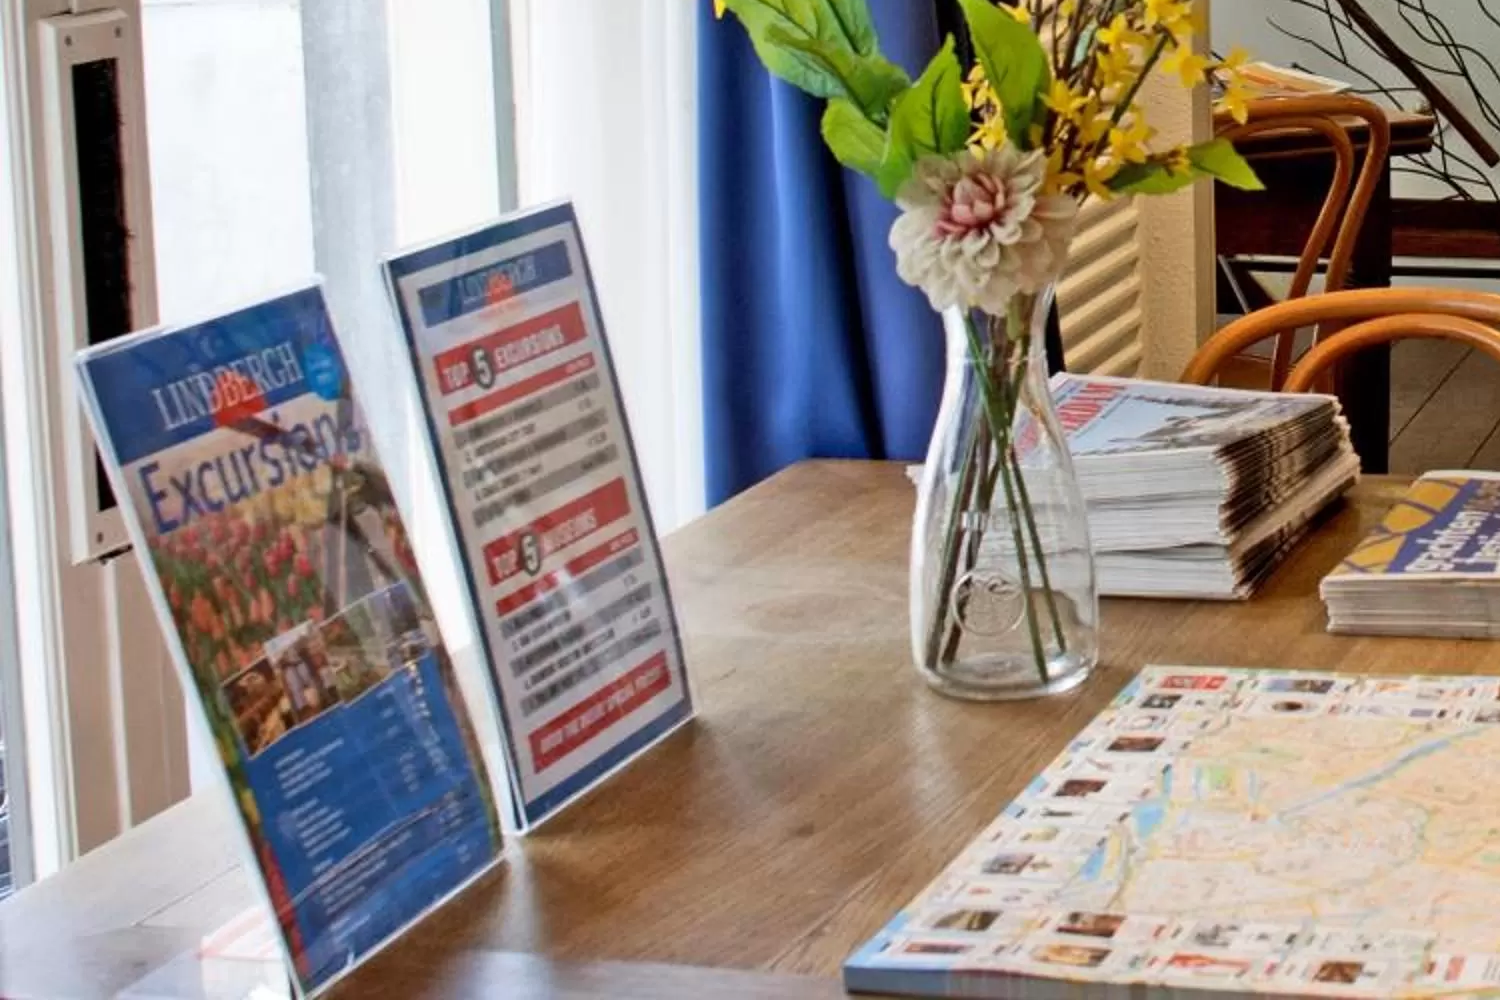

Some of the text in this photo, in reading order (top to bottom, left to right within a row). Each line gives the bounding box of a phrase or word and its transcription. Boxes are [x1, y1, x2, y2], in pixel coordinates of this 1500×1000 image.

[151, 342, 305, 431] LINDBERGH
[442, 361, 470, 389] TOP
[472, 348, 491, 385] 5
[493, 323, 564, 368] EXCURSIONS
[521, 534, 539, 573] 5
